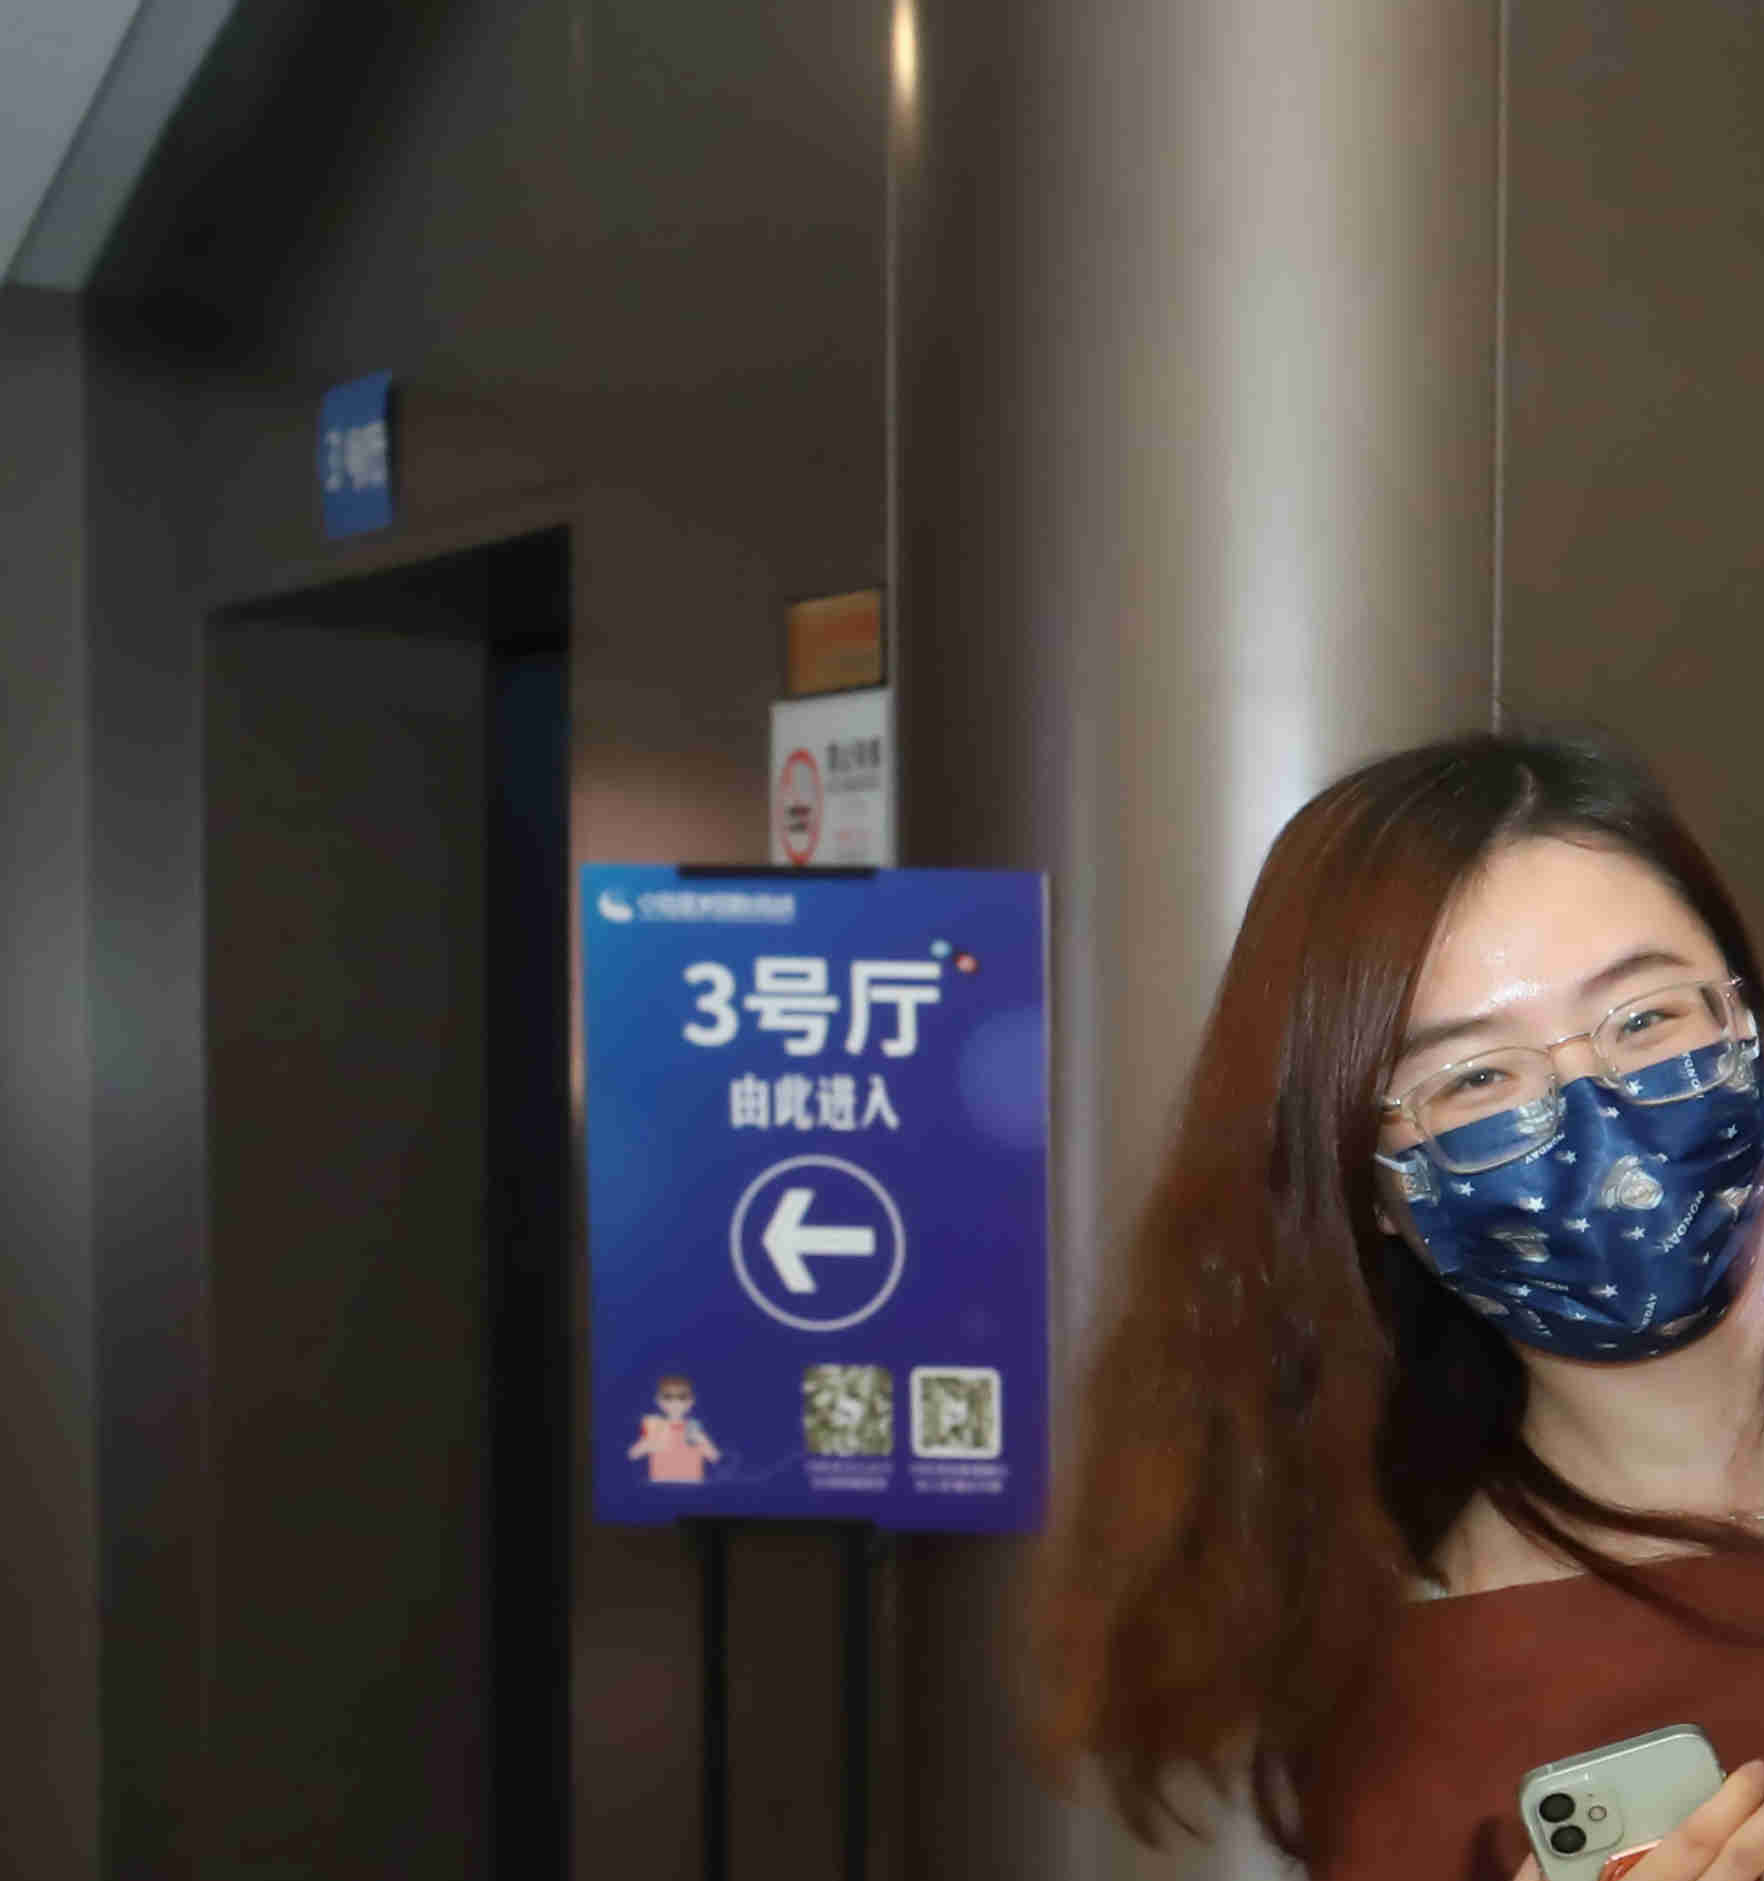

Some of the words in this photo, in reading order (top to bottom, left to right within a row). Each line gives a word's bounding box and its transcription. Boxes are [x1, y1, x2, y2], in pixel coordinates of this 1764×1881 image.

[682, 955, 942, 1057] 3号厅
[729, 1070, 901, 1131] 由此进入
[1662, 1190, 1705, 1253] MONDAY
